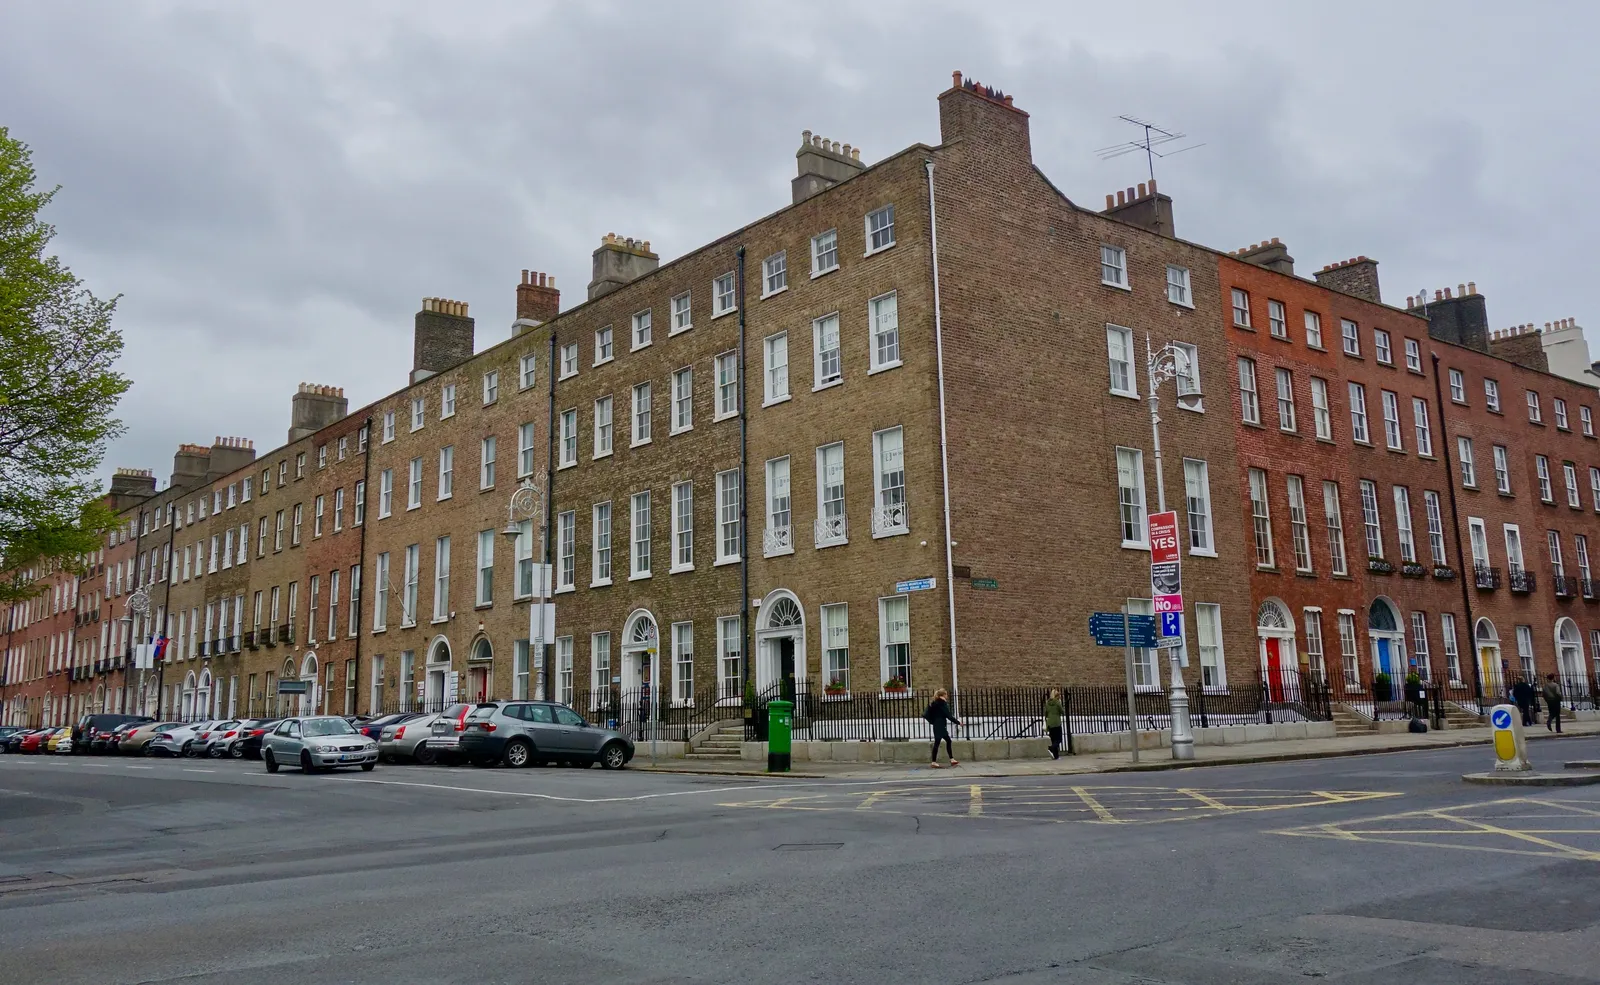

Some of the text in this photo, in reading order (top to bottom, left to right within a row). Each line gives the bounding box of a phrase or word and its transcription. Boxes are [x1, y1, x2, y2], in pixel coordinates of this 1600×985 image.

[1152, 536, 1176, 549] YES
[1156, 600, 1171, 611] NO
[1166, 612, 1175, 625] P
